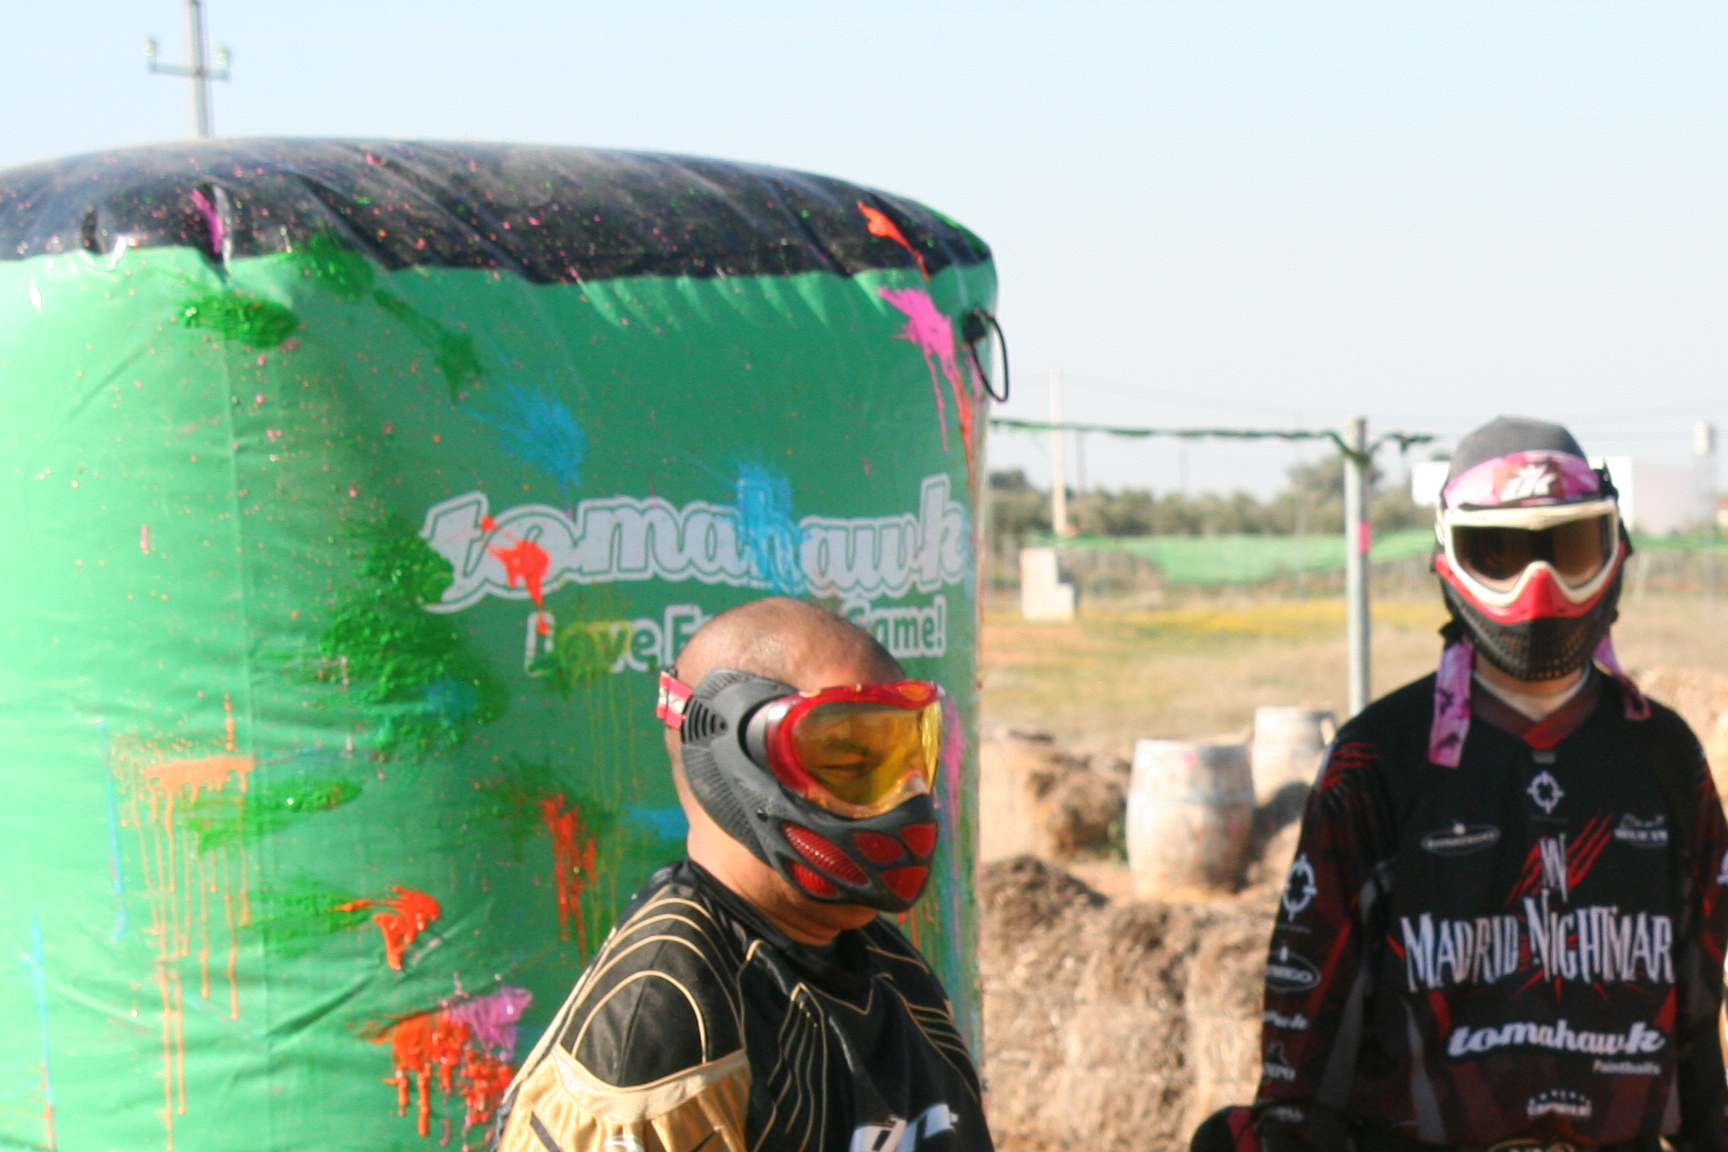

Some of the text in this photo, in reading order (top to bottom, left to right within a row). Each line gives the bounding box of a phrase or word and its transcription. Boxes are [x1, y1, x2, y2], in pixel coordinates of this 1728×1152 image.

[421, 475, 966, 613] tomahawk
[1400, 911, 1519, 992] MADRID
[1447, 1018, 1666, 1058] tomahawk
